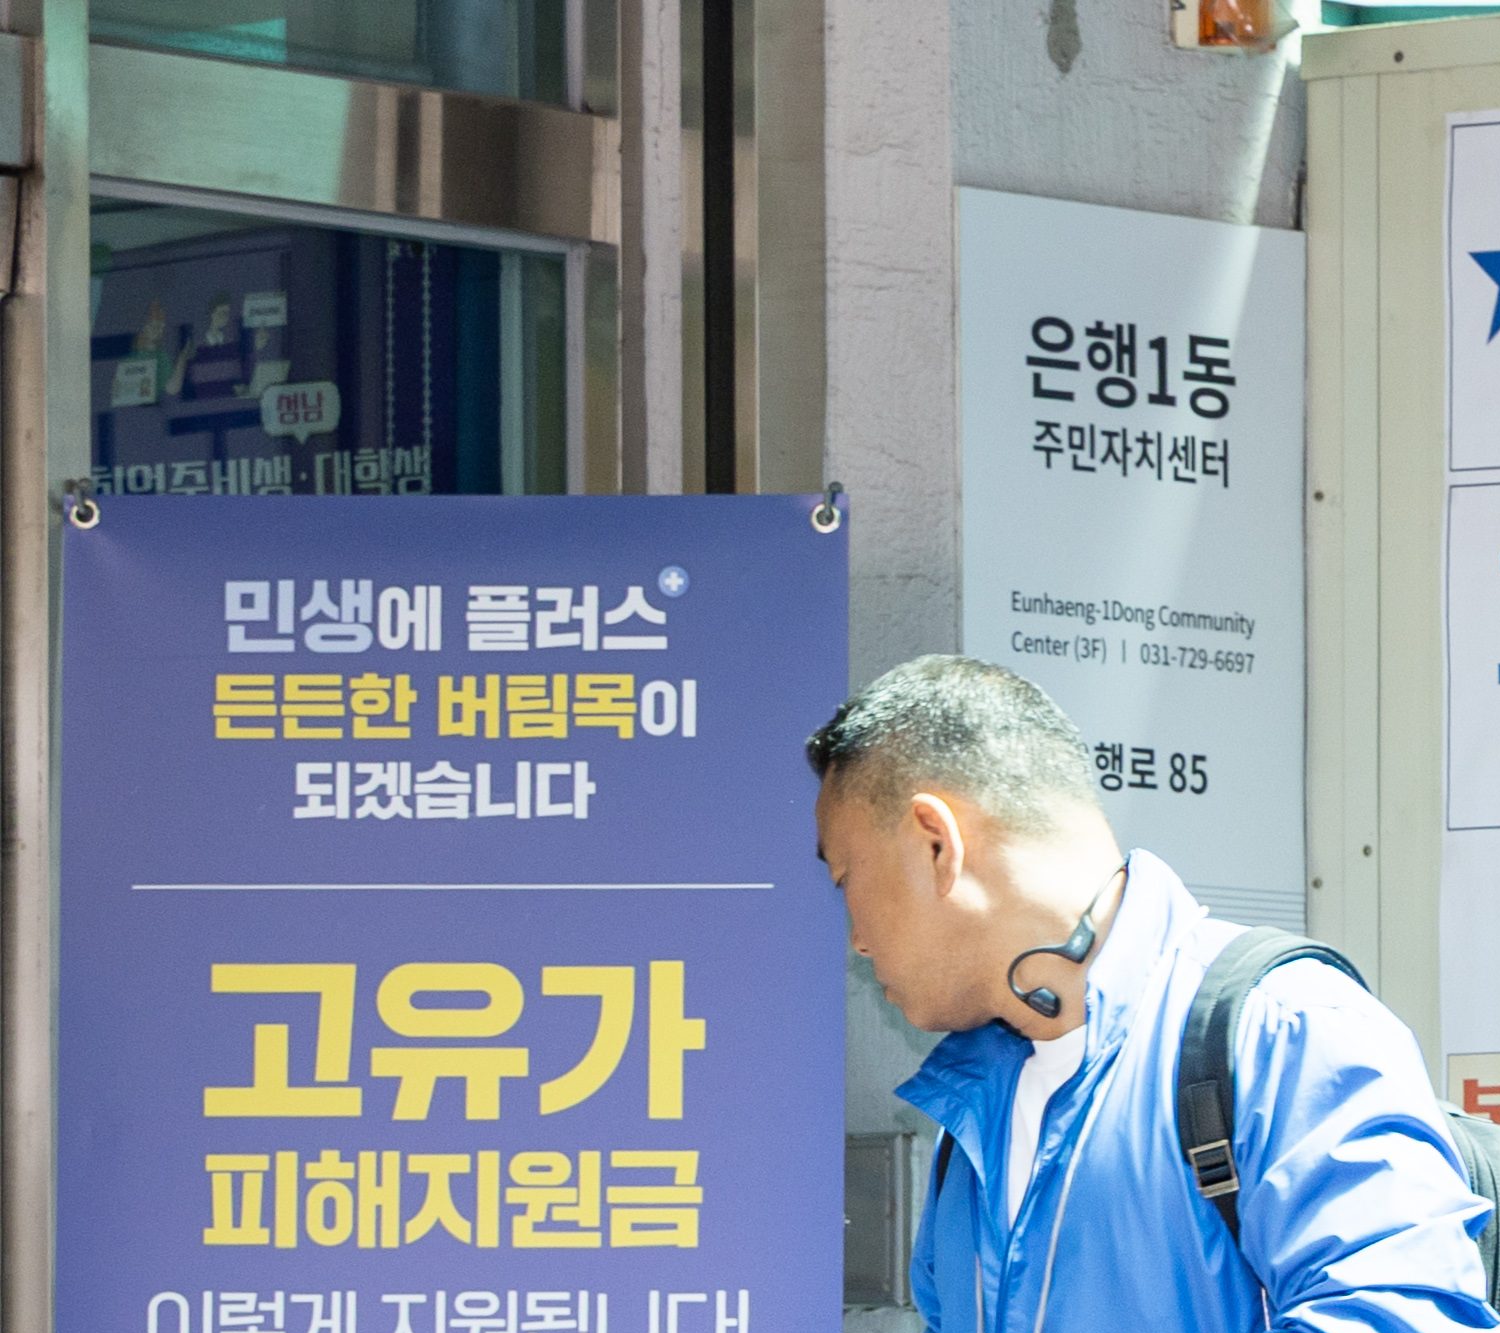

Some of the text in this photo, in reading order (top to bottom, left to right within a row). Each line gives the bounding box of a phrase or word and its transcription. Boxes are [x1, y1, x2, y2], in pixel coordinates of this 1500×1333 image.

[1026, 315, 1236, 420] 은행1동
[1032, 419, 1230, 488] 주민자치센터
[223, 579, 668, 653] 민생에 플러스
[1011, 591, 1256, 640] Eunhaeng-1Dong Community
[1011, 631, 1256, 675] Center (3F) 031-729-6697
[212, 672, 697, 739] 든든한 버팀목이
[293, 760, 596, 820] 되겠습니다
[1086, 741, 1209, 795] 행로 85
[203, 960, 706, 1121] 고유가
[203, 1150, 704, 1249] 피해지원금
